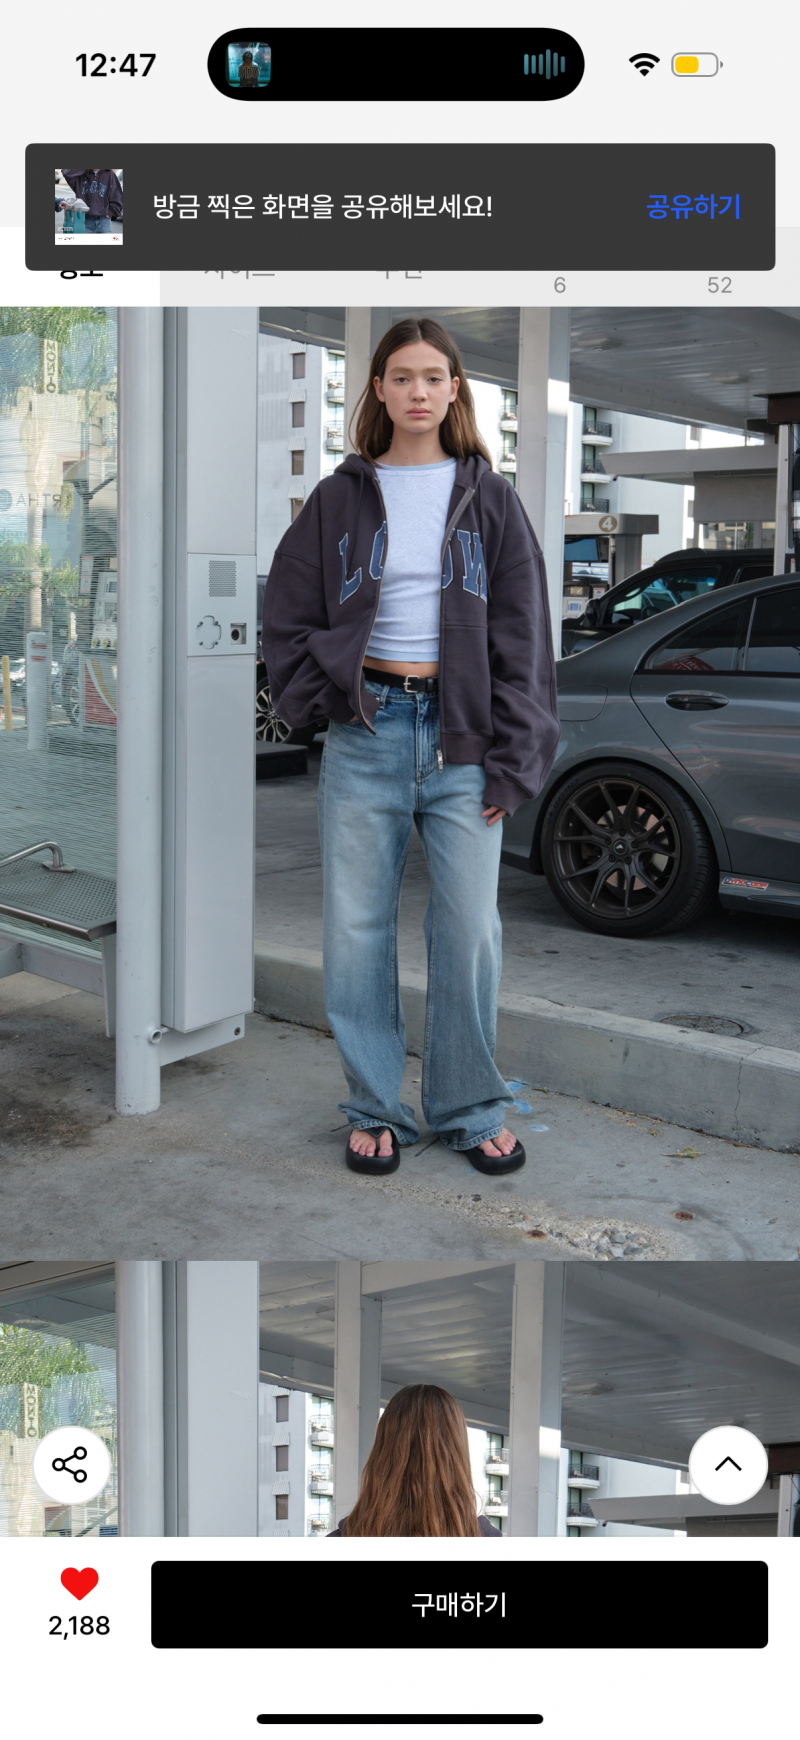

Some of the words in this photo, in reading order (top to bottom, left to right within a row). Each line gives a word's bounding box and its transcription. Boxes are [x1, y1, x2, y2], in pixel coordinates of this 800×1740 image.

[75, 52, 157, 77] 12:47
[153, 193, 201, 220] 방금
[207, 193, 256, 220] 찍은
[262, 193, 335, 220] 화면을
[341, 193, 492, 220] 공유해보세요!
[646, 193, 740, 220] 공유하기
[553, 276, 566, 294] 6
[707, 276, 733, 294] 52
[601, 516, 613, 531] 4
[411, 1592, 506, 1618] 구매하기
[48, 1615, 111, 1641] 2,188
